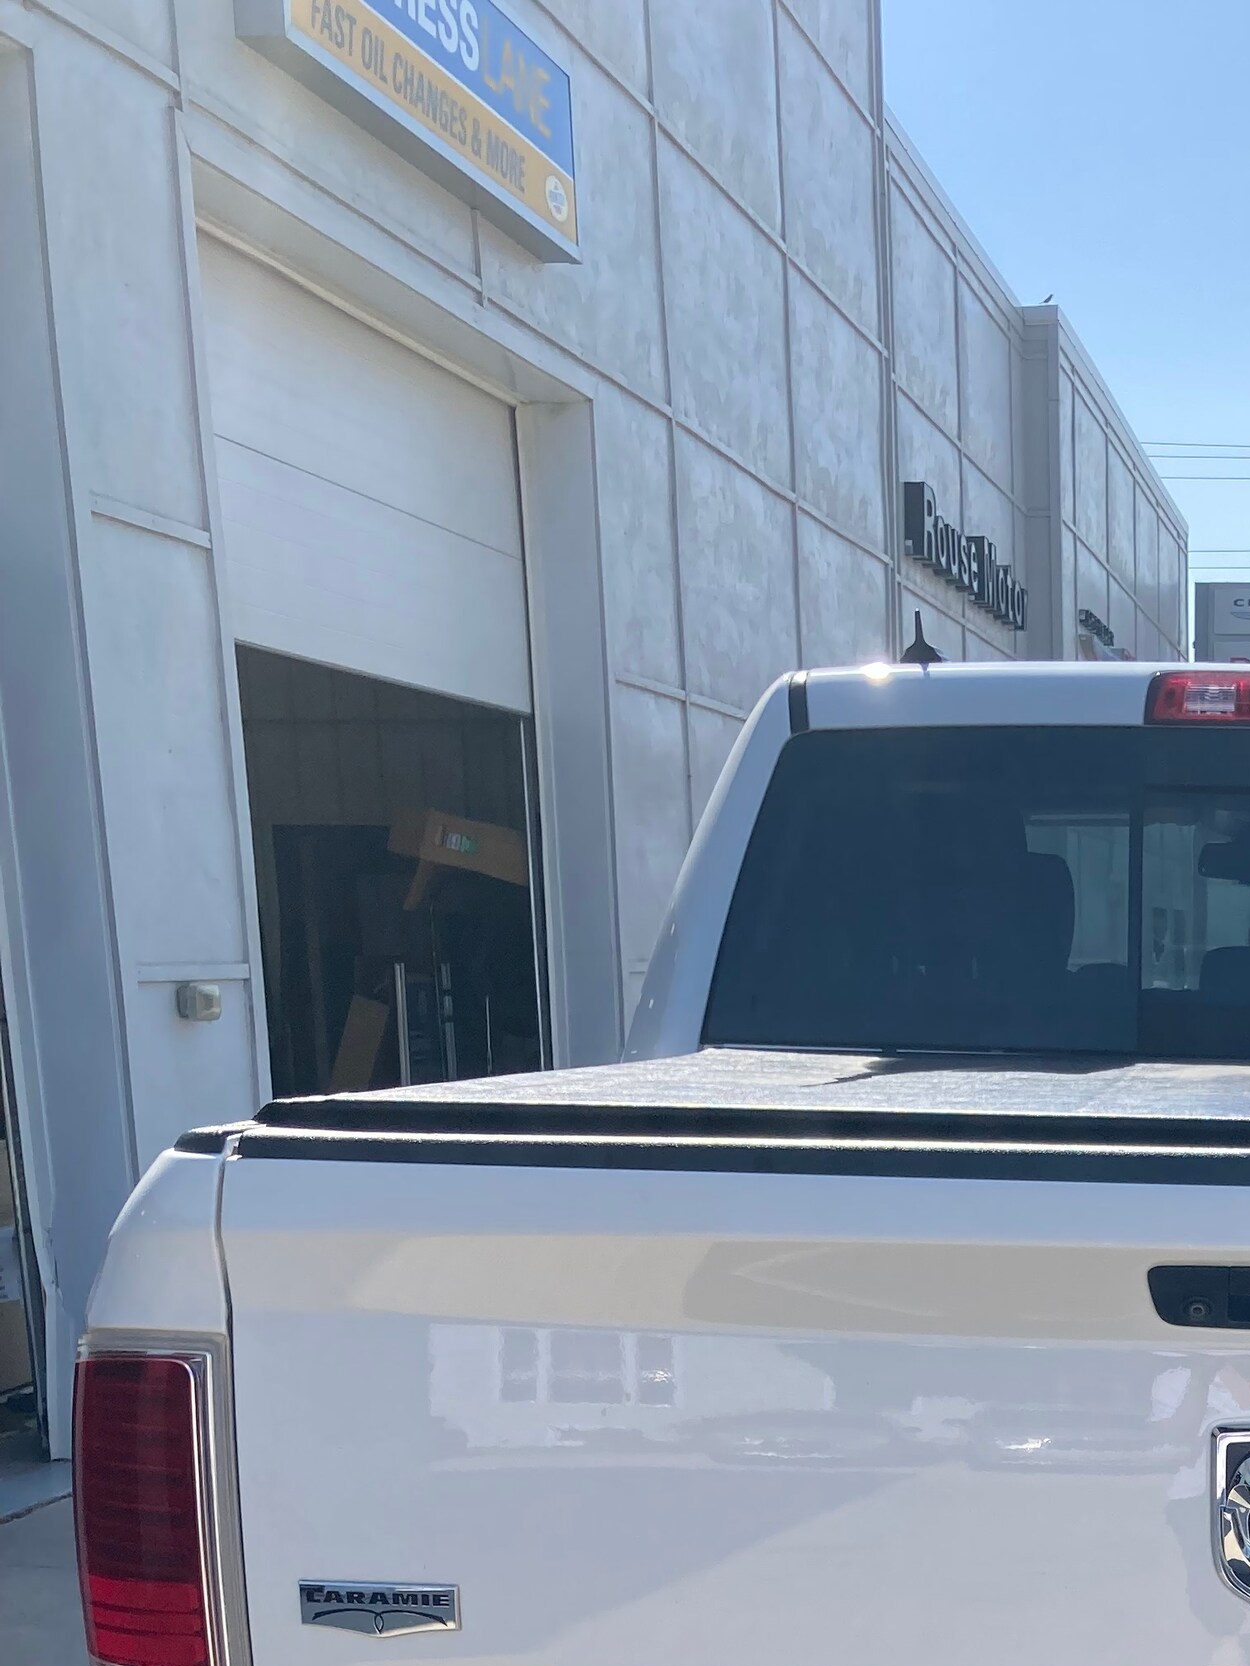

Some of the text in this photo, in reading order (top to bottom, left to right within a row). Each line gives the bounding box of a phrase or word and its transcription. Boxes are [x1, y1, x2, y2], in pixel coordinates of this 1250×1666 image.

[394, 0, 479, 71] ESS
[311, 0, 525, 194] FAST OIL CHANGES & MORE
[917, 482, 979, 593] Rouse
